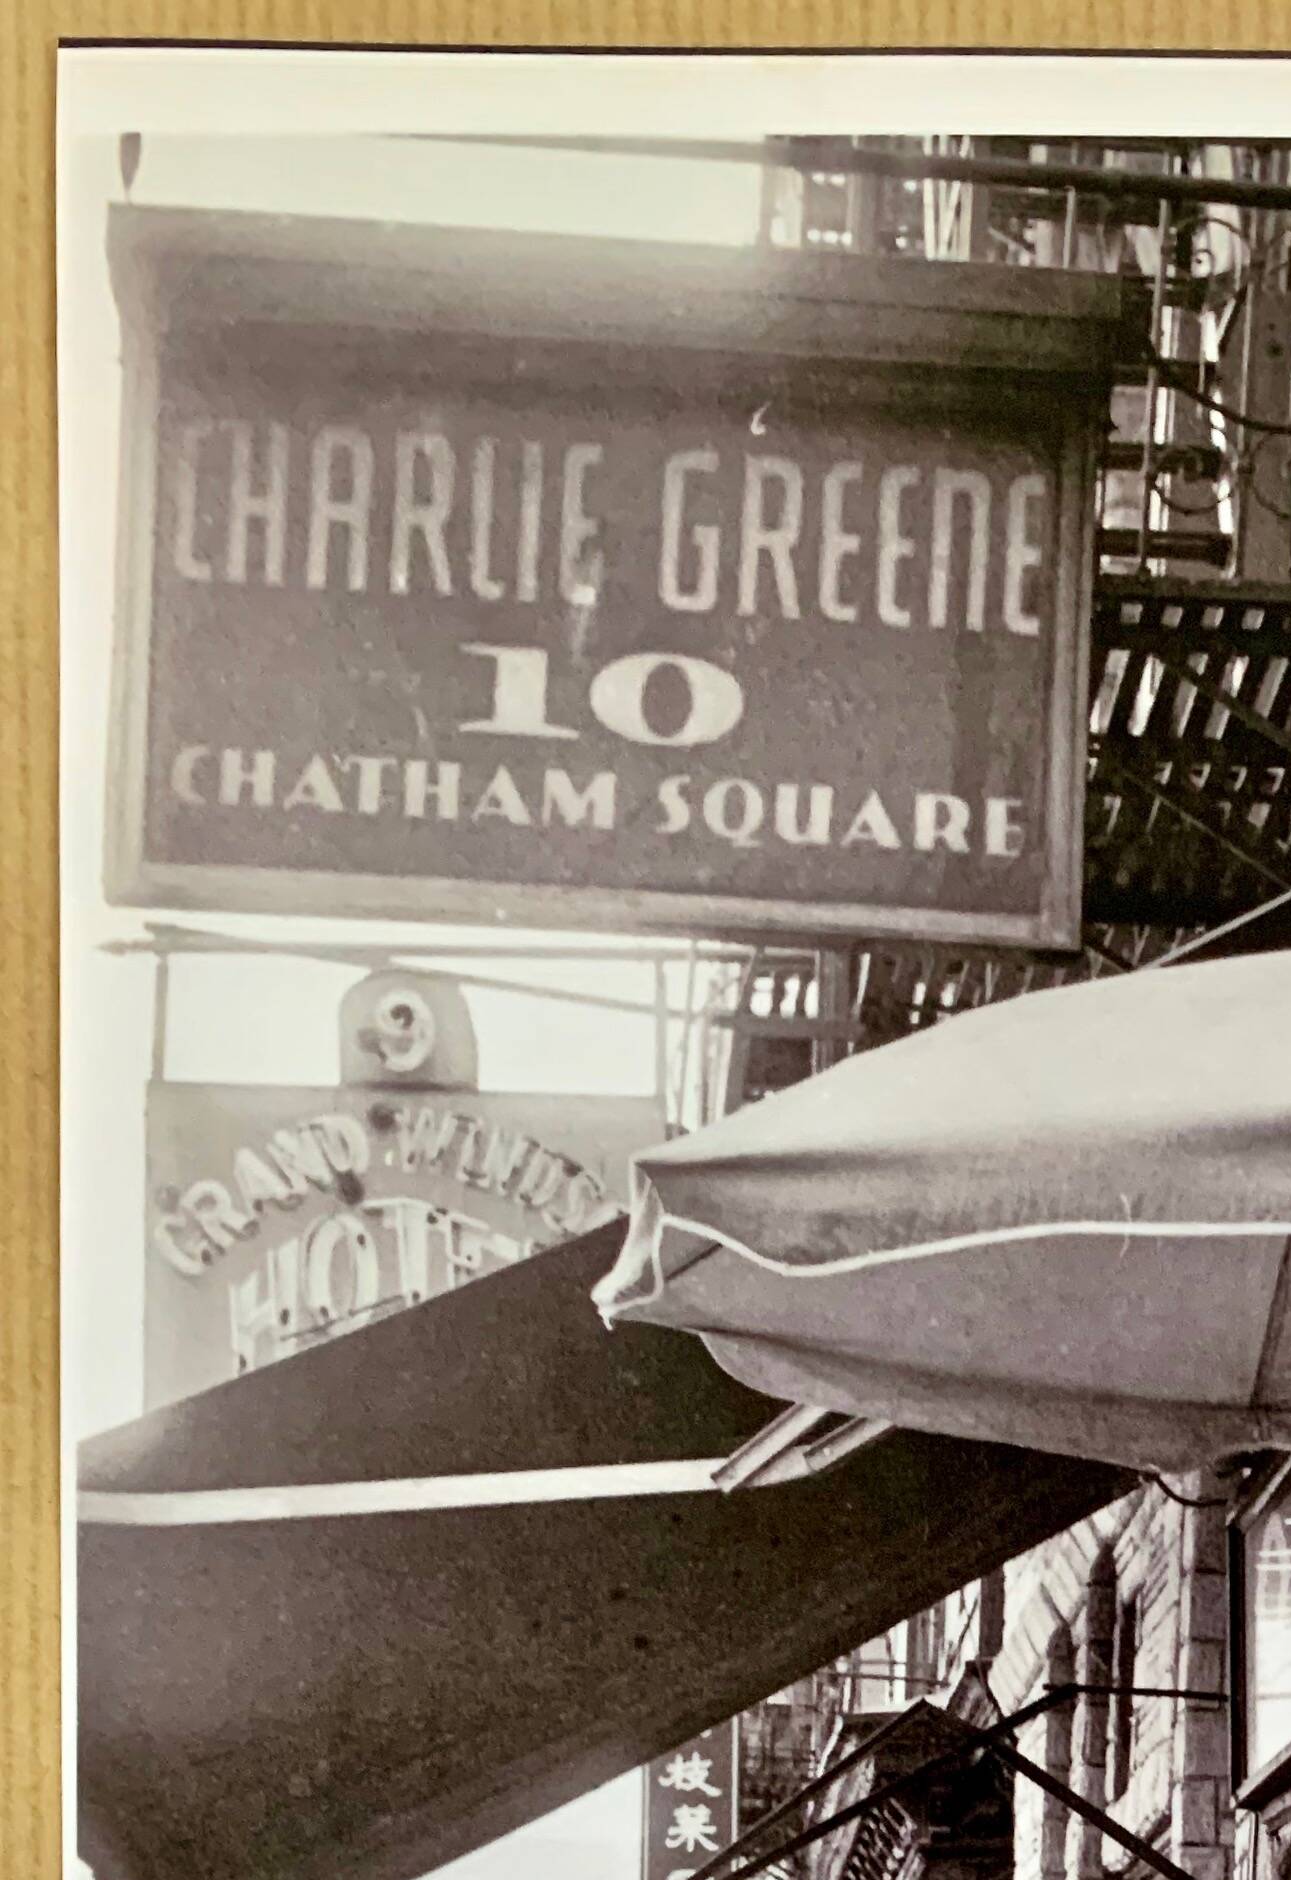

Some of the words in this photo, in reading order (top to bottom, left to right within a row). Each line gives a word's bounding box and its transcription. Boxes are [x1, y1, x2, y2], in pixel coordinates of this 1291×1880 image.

[171, 417, 603, 605] CHARLIE
[657, 446, 1051, 638] GREENE
[458, 642, 744, 748] 10
[169, 744, 617, 831] CHATHAM
[655, 773, 1026, 860] SQUARE
[360, 989, 436, 1073] 9
[155, 1113, 370, 1276] GRAND
